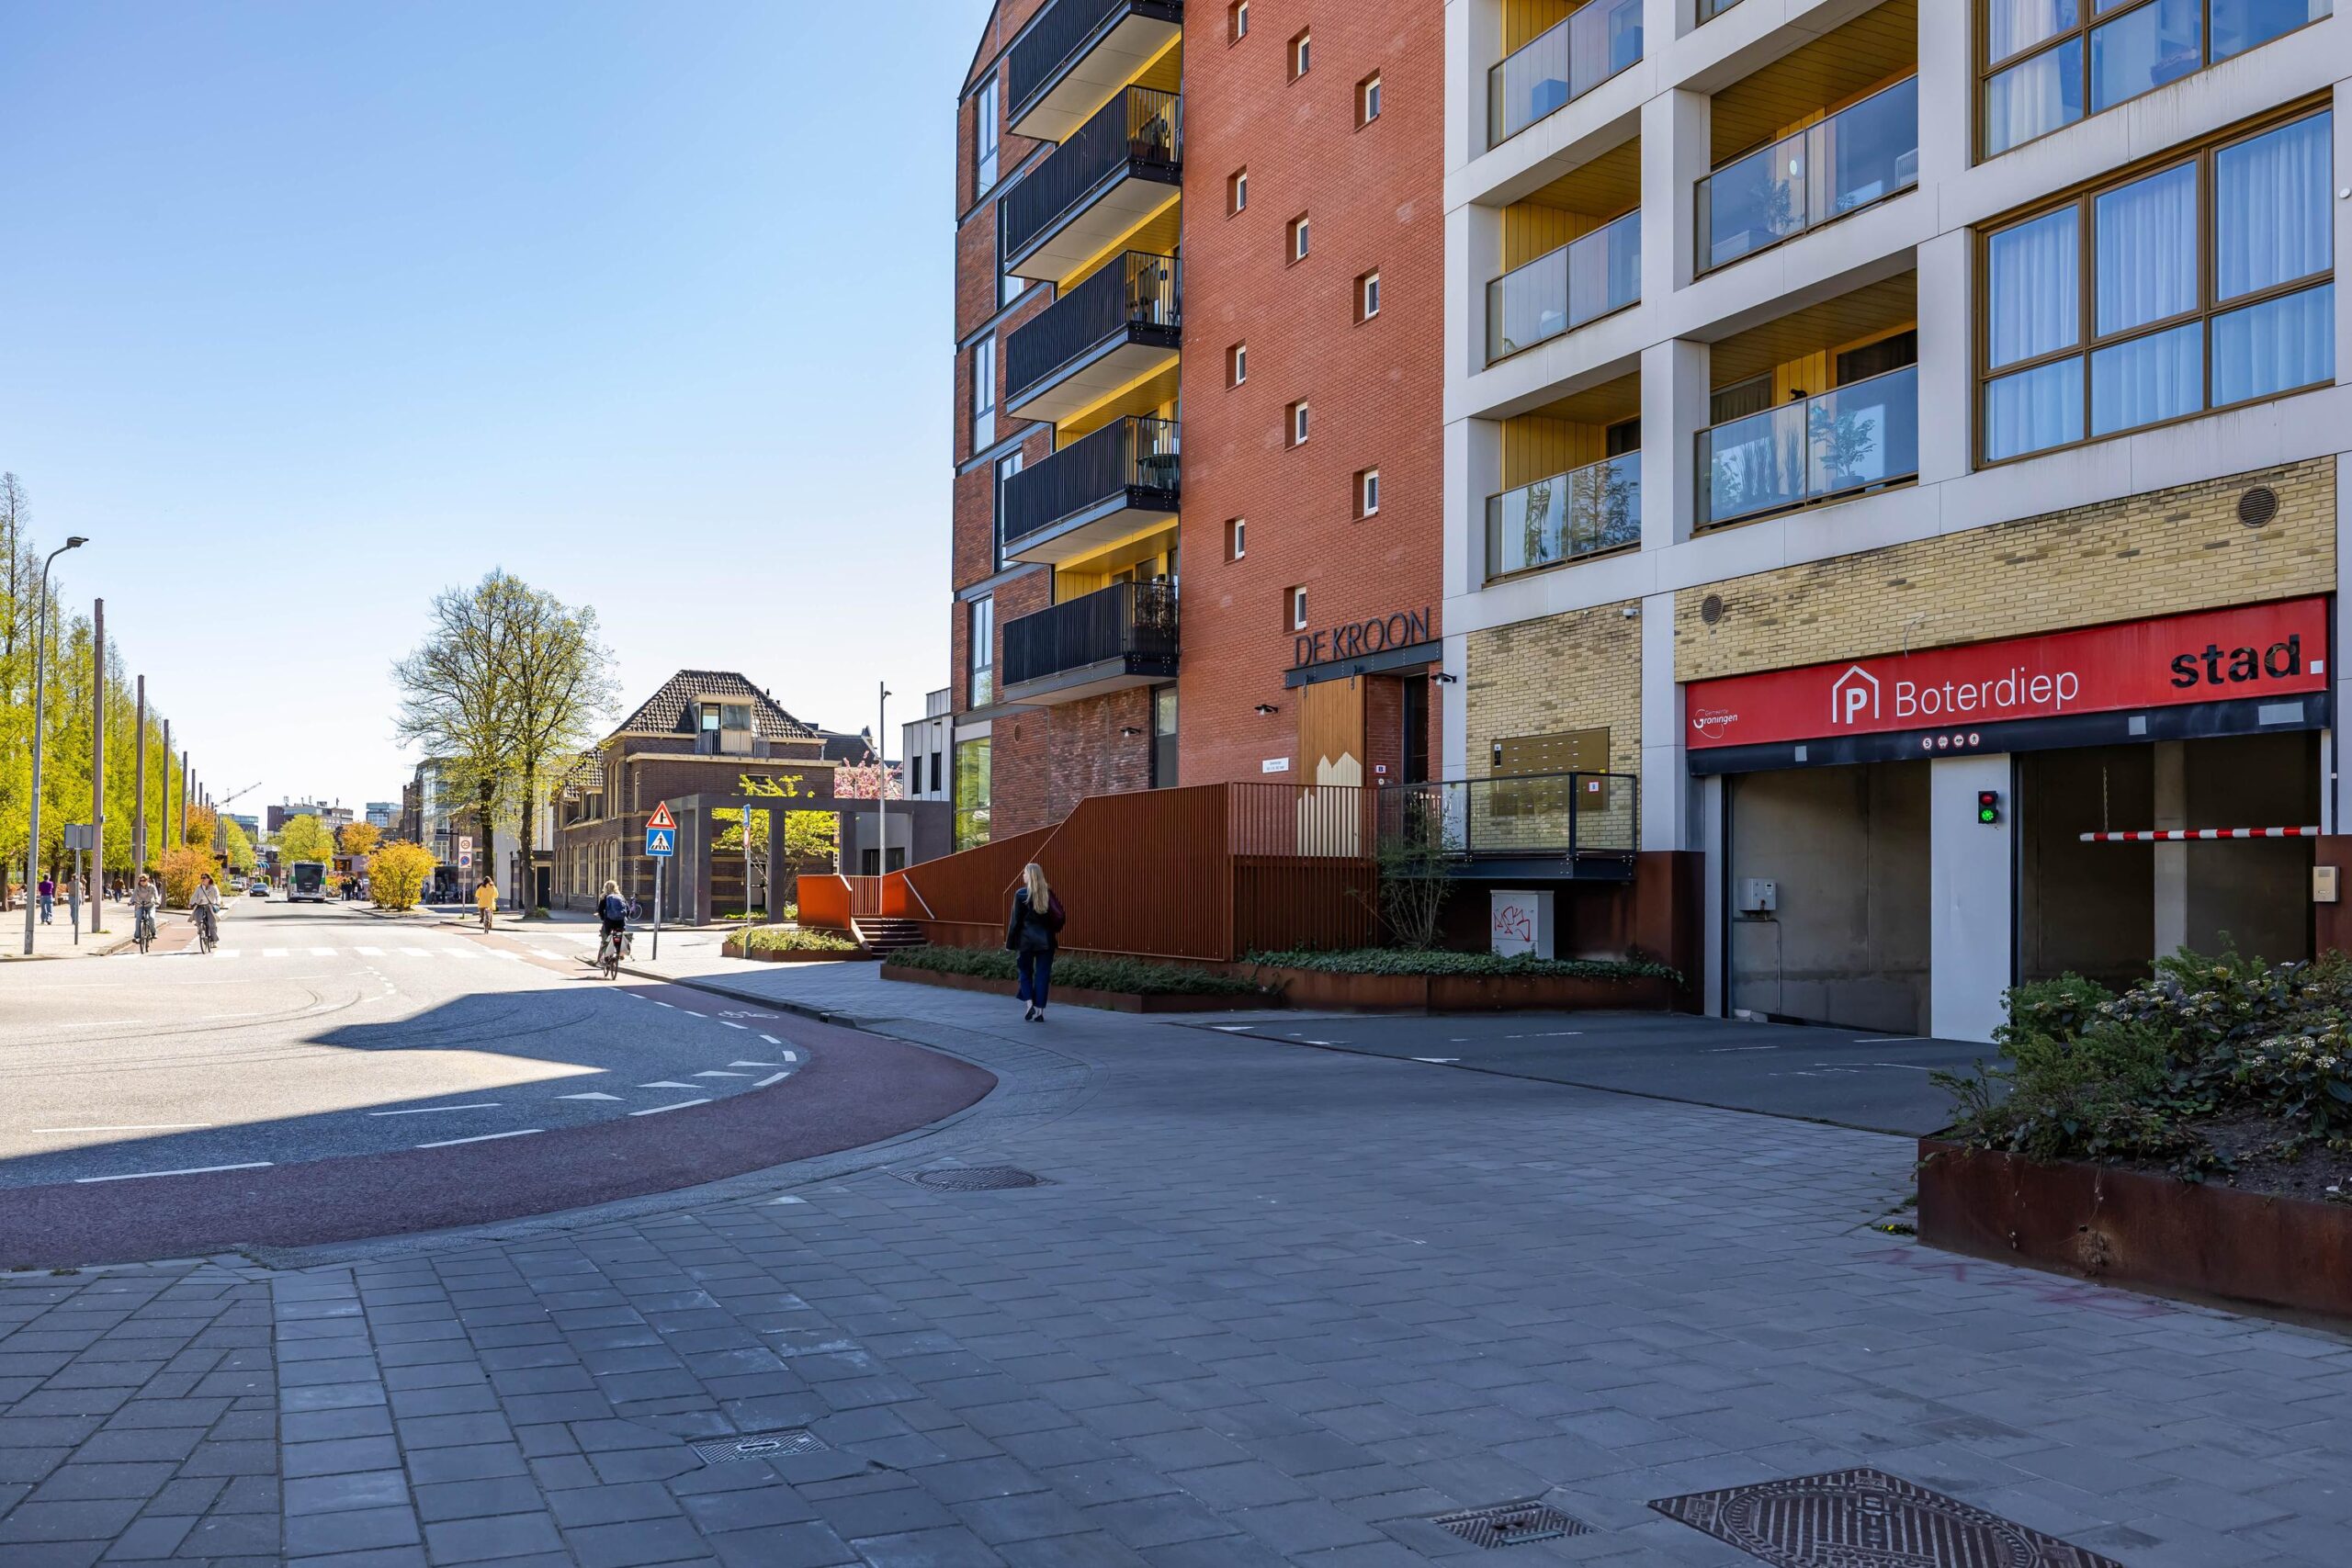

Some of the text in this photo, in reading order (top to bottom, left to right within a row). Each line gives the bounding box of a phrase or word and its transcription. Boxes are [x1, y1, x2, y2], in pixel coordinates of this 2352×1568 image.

[1295, 606, 1429, 669] DE KROON
[1692, 712, 1738, 729] Groningen
[1846, 667, 2079, 725] P Boterdiep
